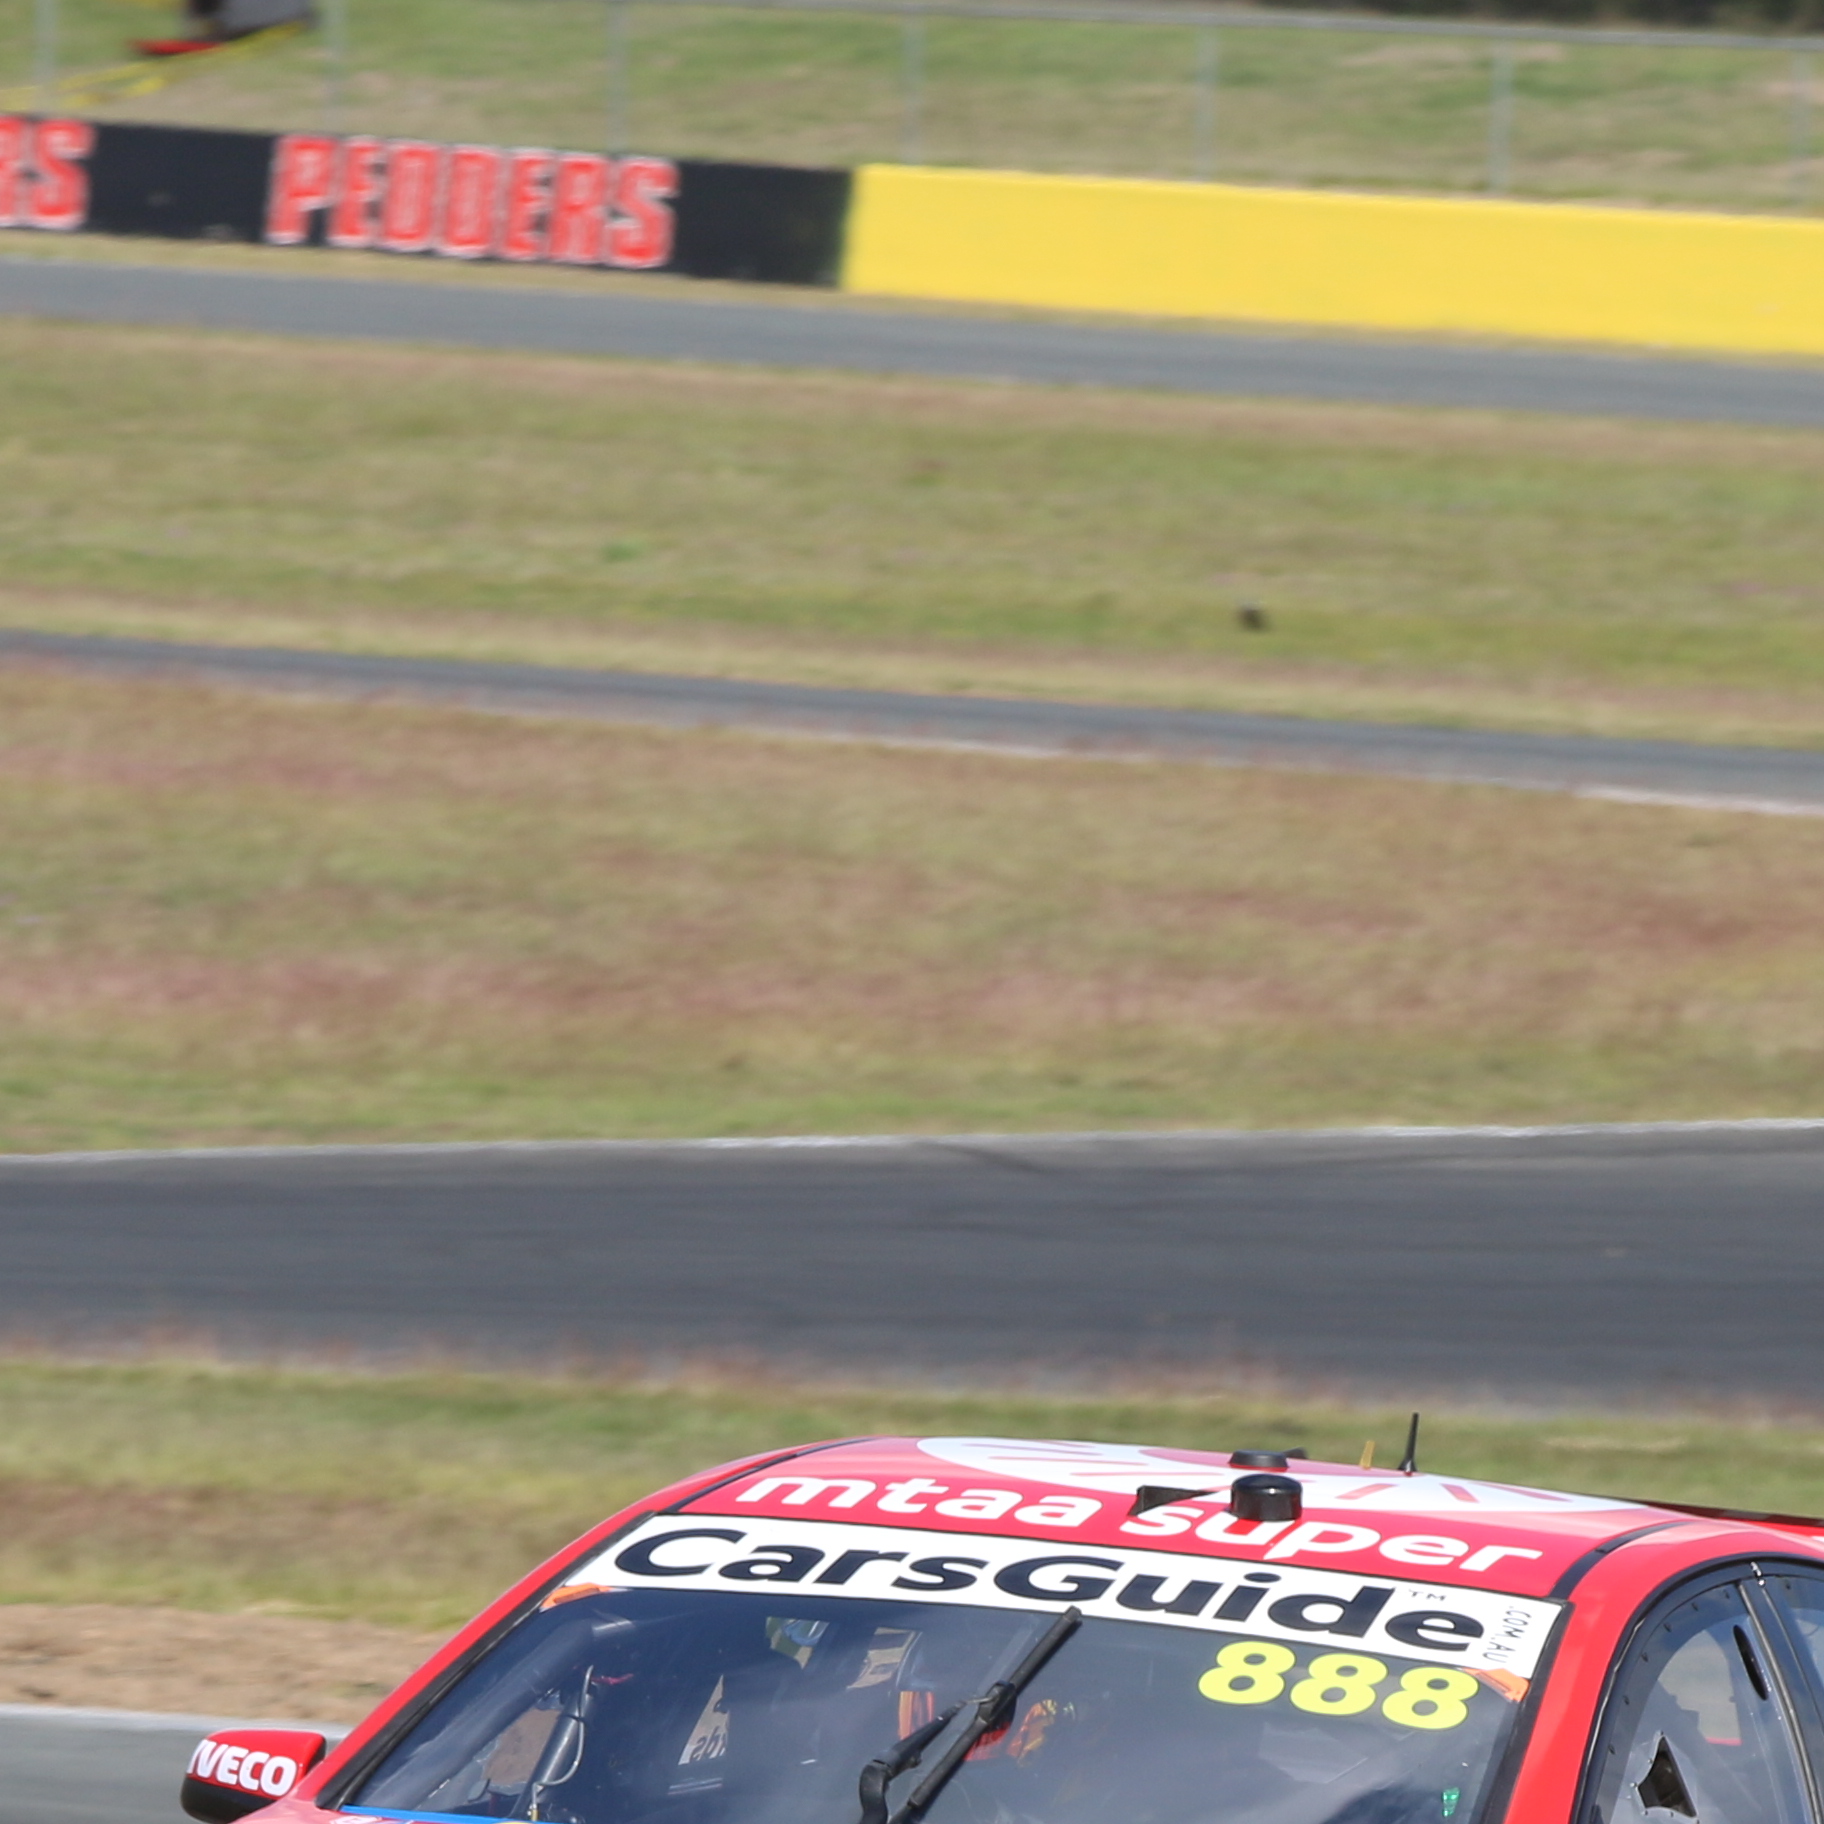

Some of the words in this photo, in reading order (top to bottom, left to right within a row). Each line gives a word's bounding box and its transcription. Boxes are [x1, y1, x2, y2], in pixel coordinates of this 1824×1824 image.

[266, 132, 681, 269] PEDDERS
[736, 1476, 1103, 1527] mtaa
[1120, 1503, 1543, 1574] super
[613, 1528, 1486, 1652] CarsGuide
[1198, 1641, 1479, 1731] 888
[186, 1738, 298, 1797] IVECO
